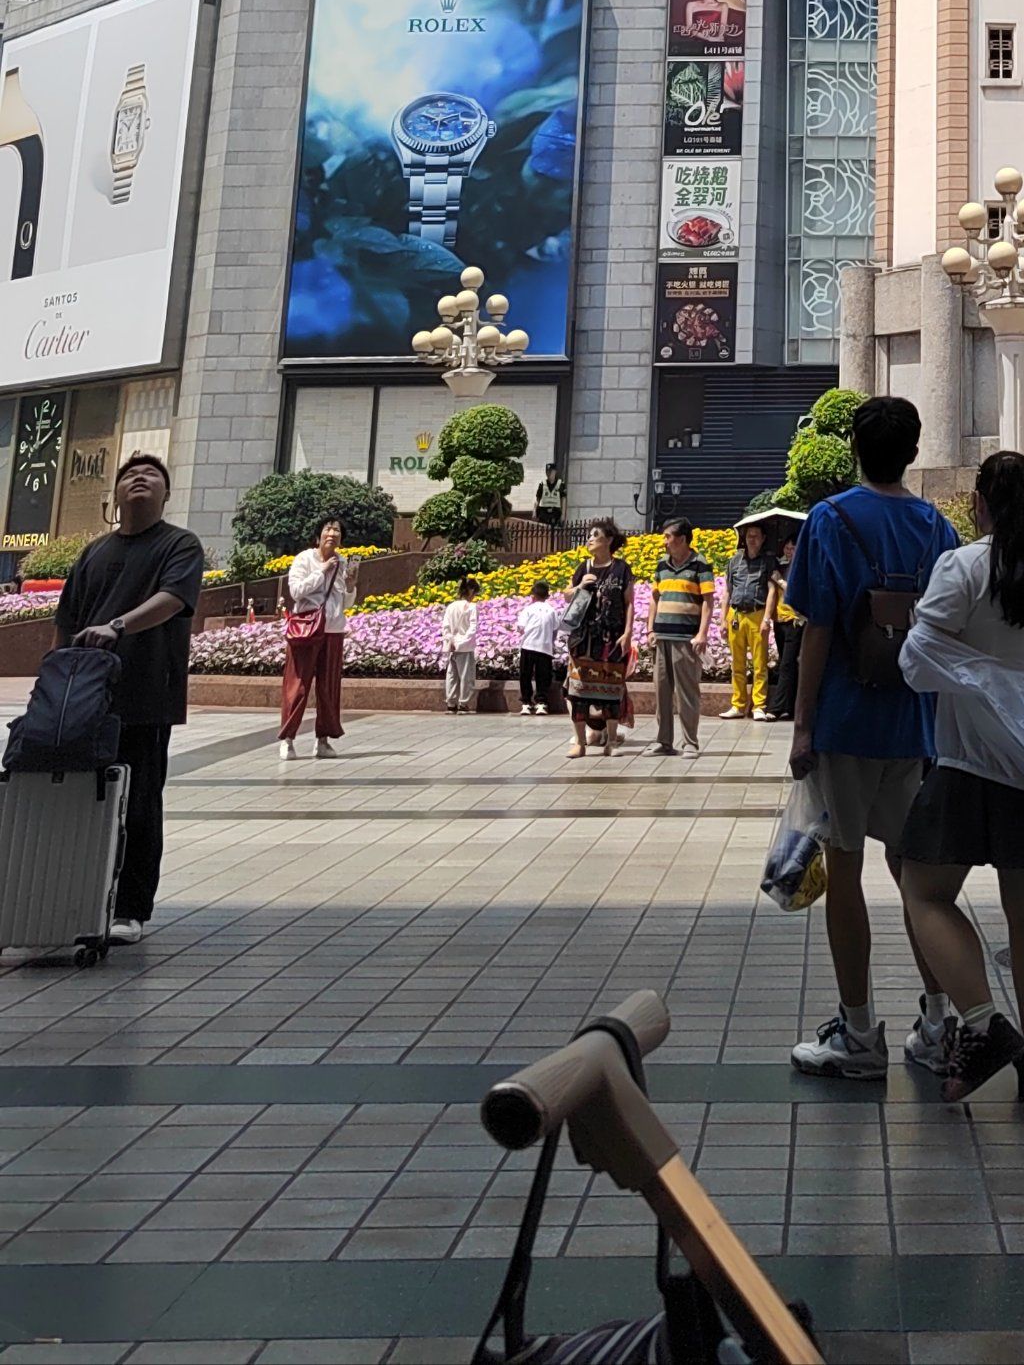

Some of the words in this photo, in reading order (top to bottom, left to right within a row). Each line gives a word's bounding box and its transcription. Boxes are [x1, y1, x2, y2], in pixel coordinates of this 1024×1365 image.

[408, 18, 487, 33] ROLEX
[44, 292, 78, 308] SANTOS
[25, 319, 90, 360] Cartier
[2, 533, 49, 547] PANERAI
